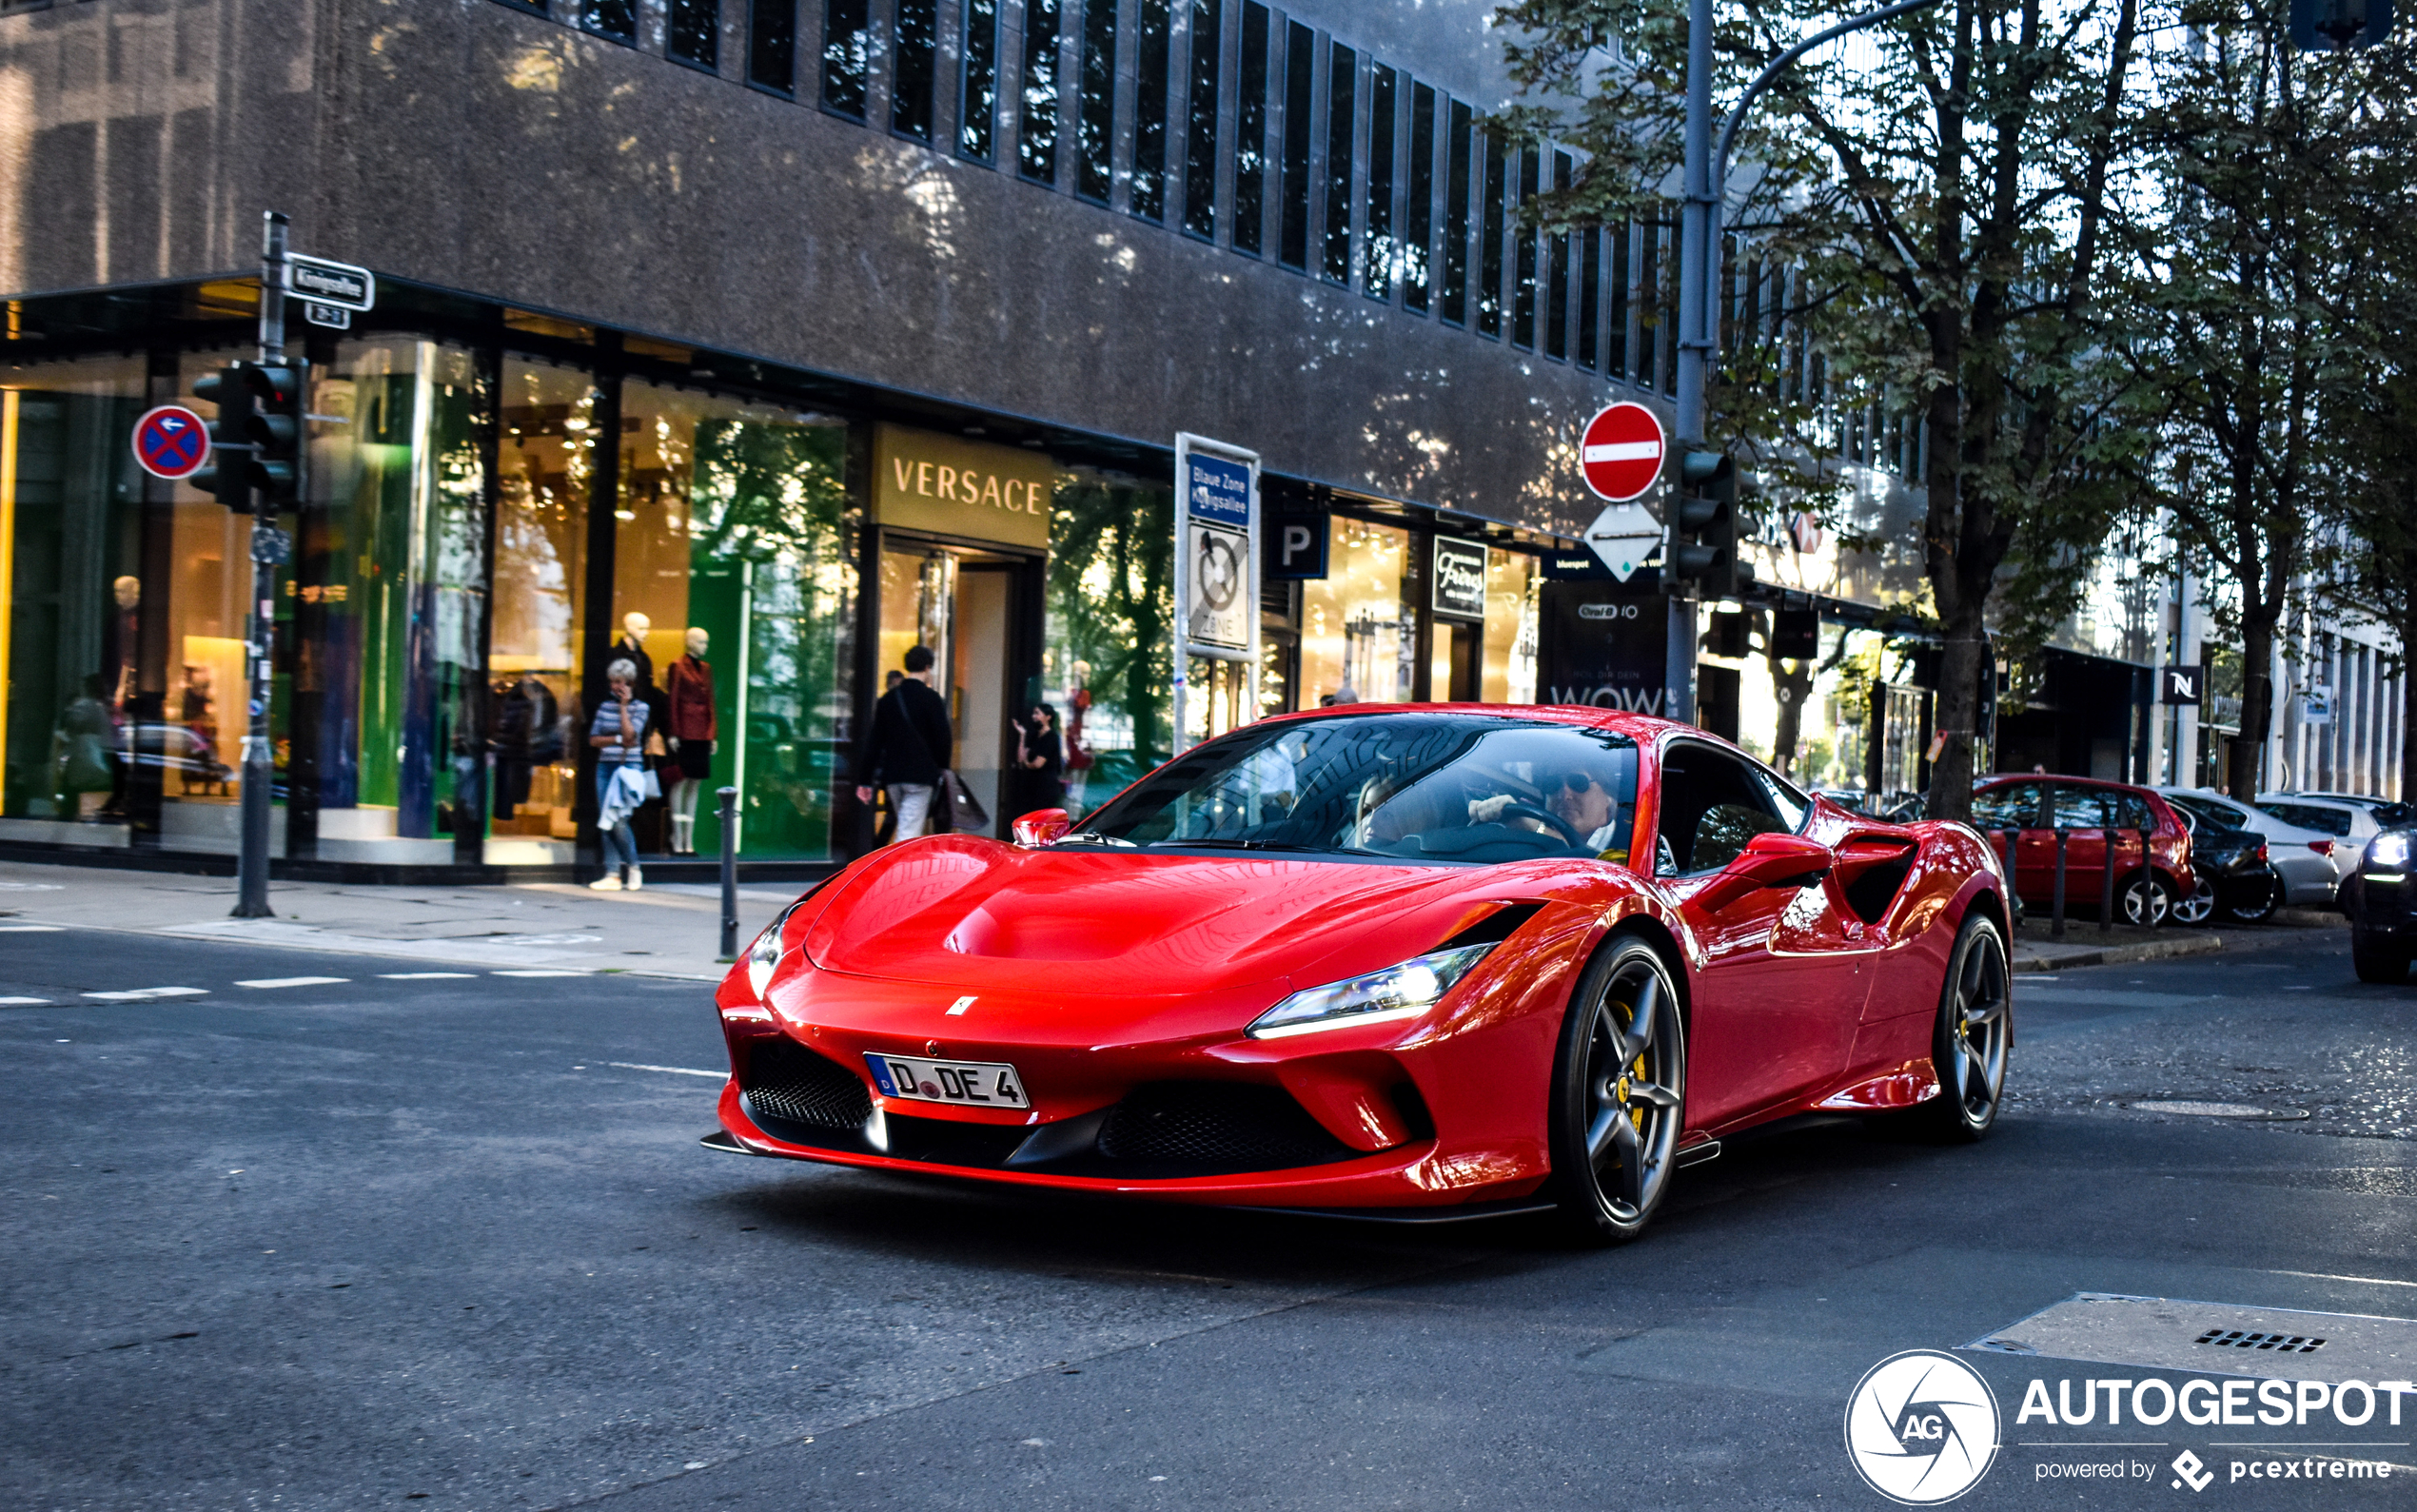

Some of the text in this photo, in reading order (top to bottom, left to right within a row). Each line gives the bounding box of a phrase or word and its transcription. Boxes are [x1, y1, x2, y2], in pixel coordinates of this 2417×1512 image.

[894, 457, 1042, 515] VERSACE
[1193, 466, 1246, 493] Blaue Zone
[1283, 525, 1311, 566] P
[1204, 615, 1233, 637] ZONE
[1550, 686, 1662, 716] WOW
[889, 1062, 1019, 1103] D DE 4
